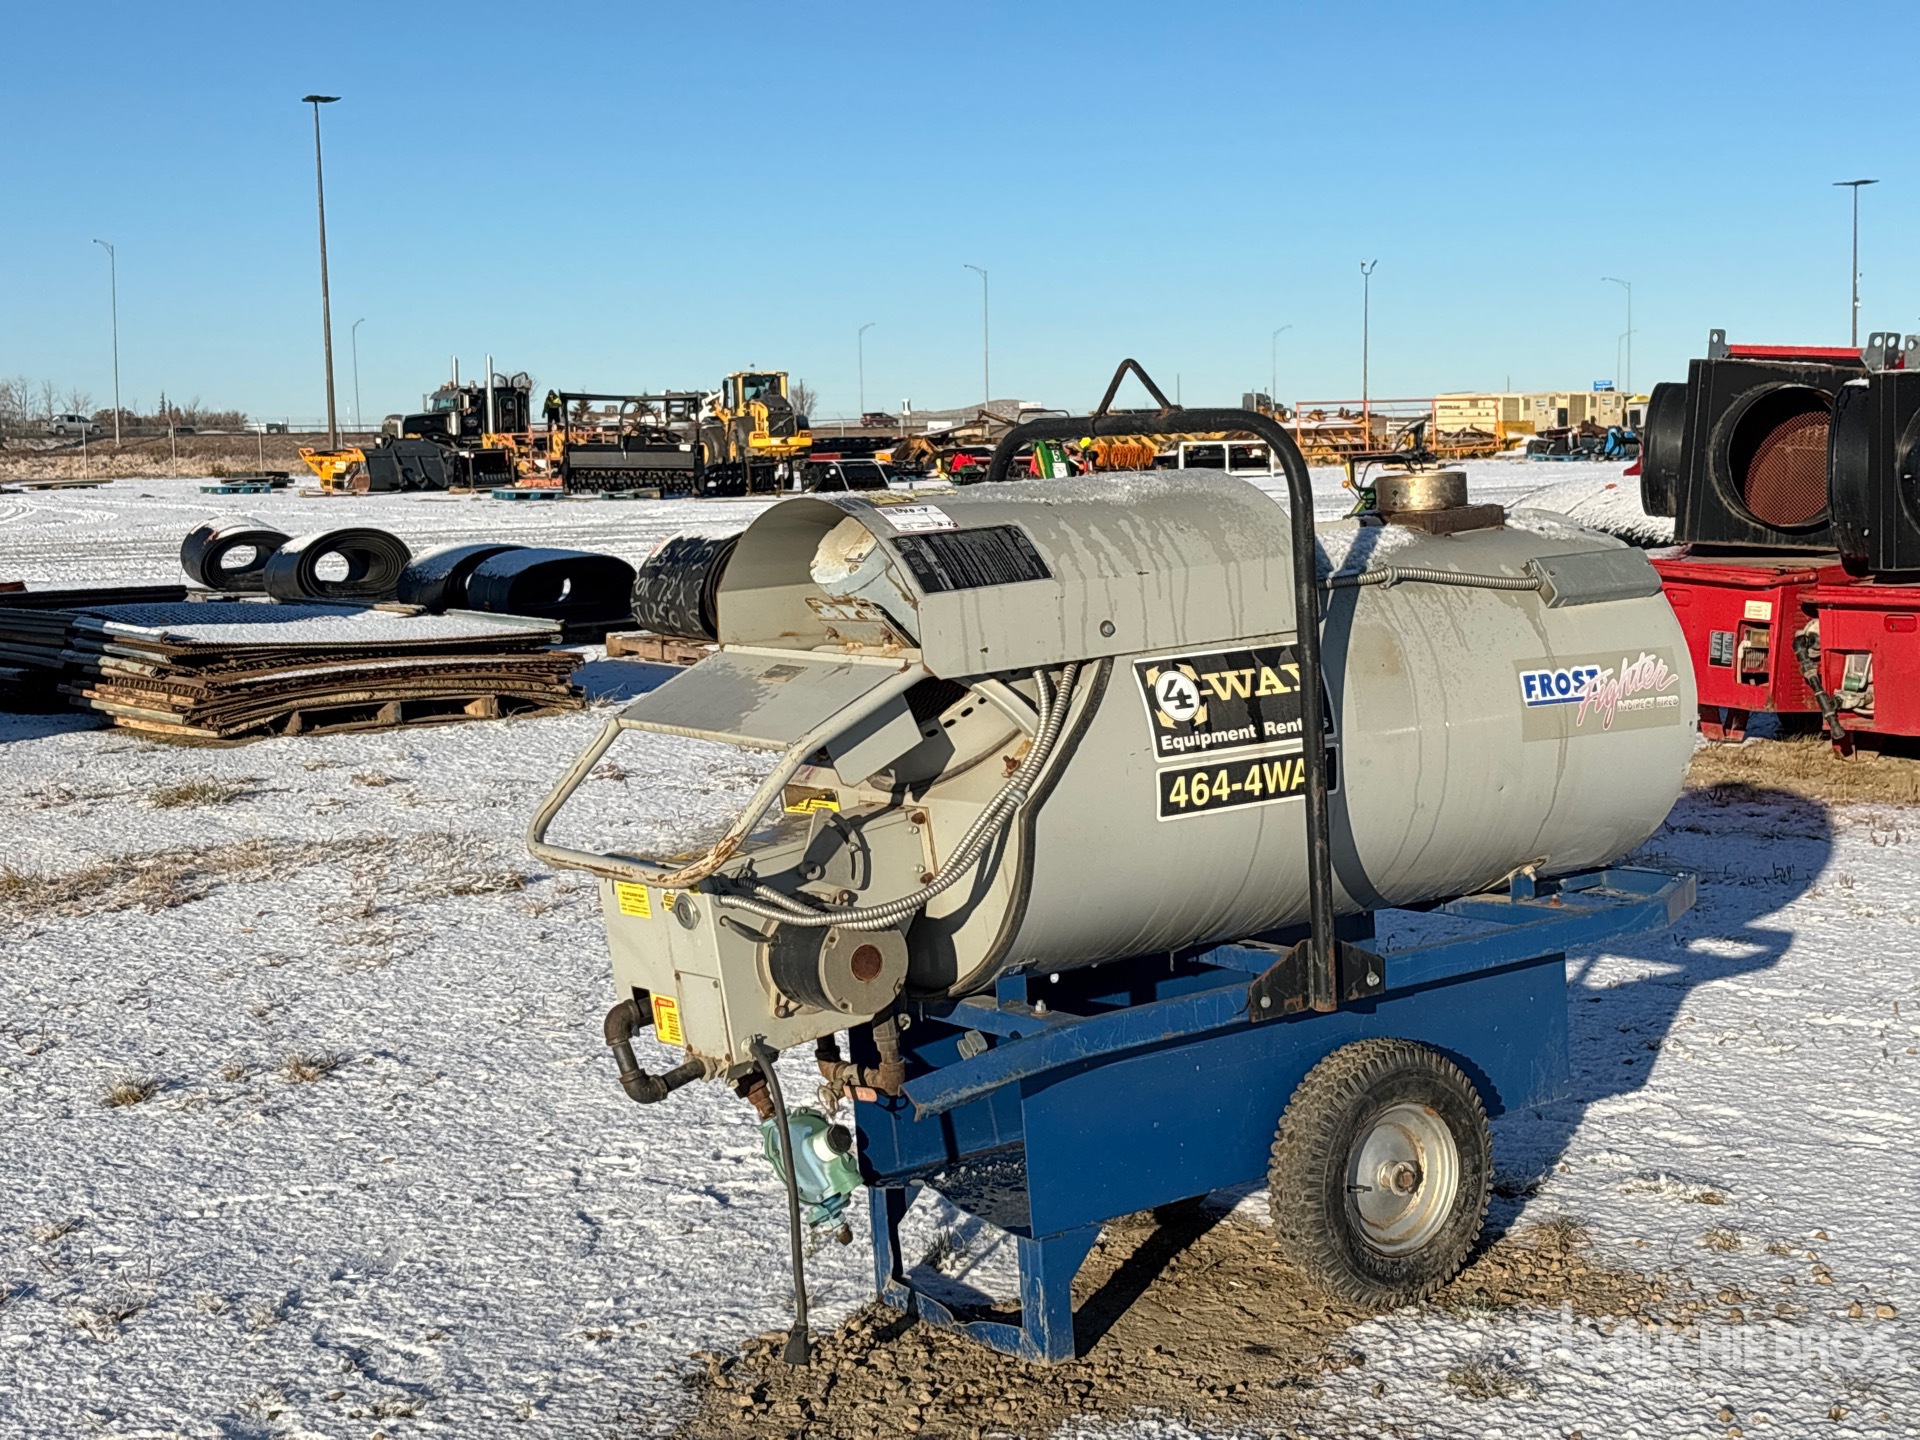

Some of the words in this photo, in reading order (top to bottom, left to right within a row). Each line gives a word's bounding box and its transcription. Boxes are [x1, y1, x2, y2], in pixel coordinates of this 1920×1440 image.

[1053, 450, 1060, 461] 5
[1522, 667, 1600, 700] FROST
[1577, 652, 1679, 730] Fighter
[1161, 724, 1257, 751] Equipment
[1263, 717, 1329, 736] Rents
[1169, 757, 1328, 808] 464-4WA
